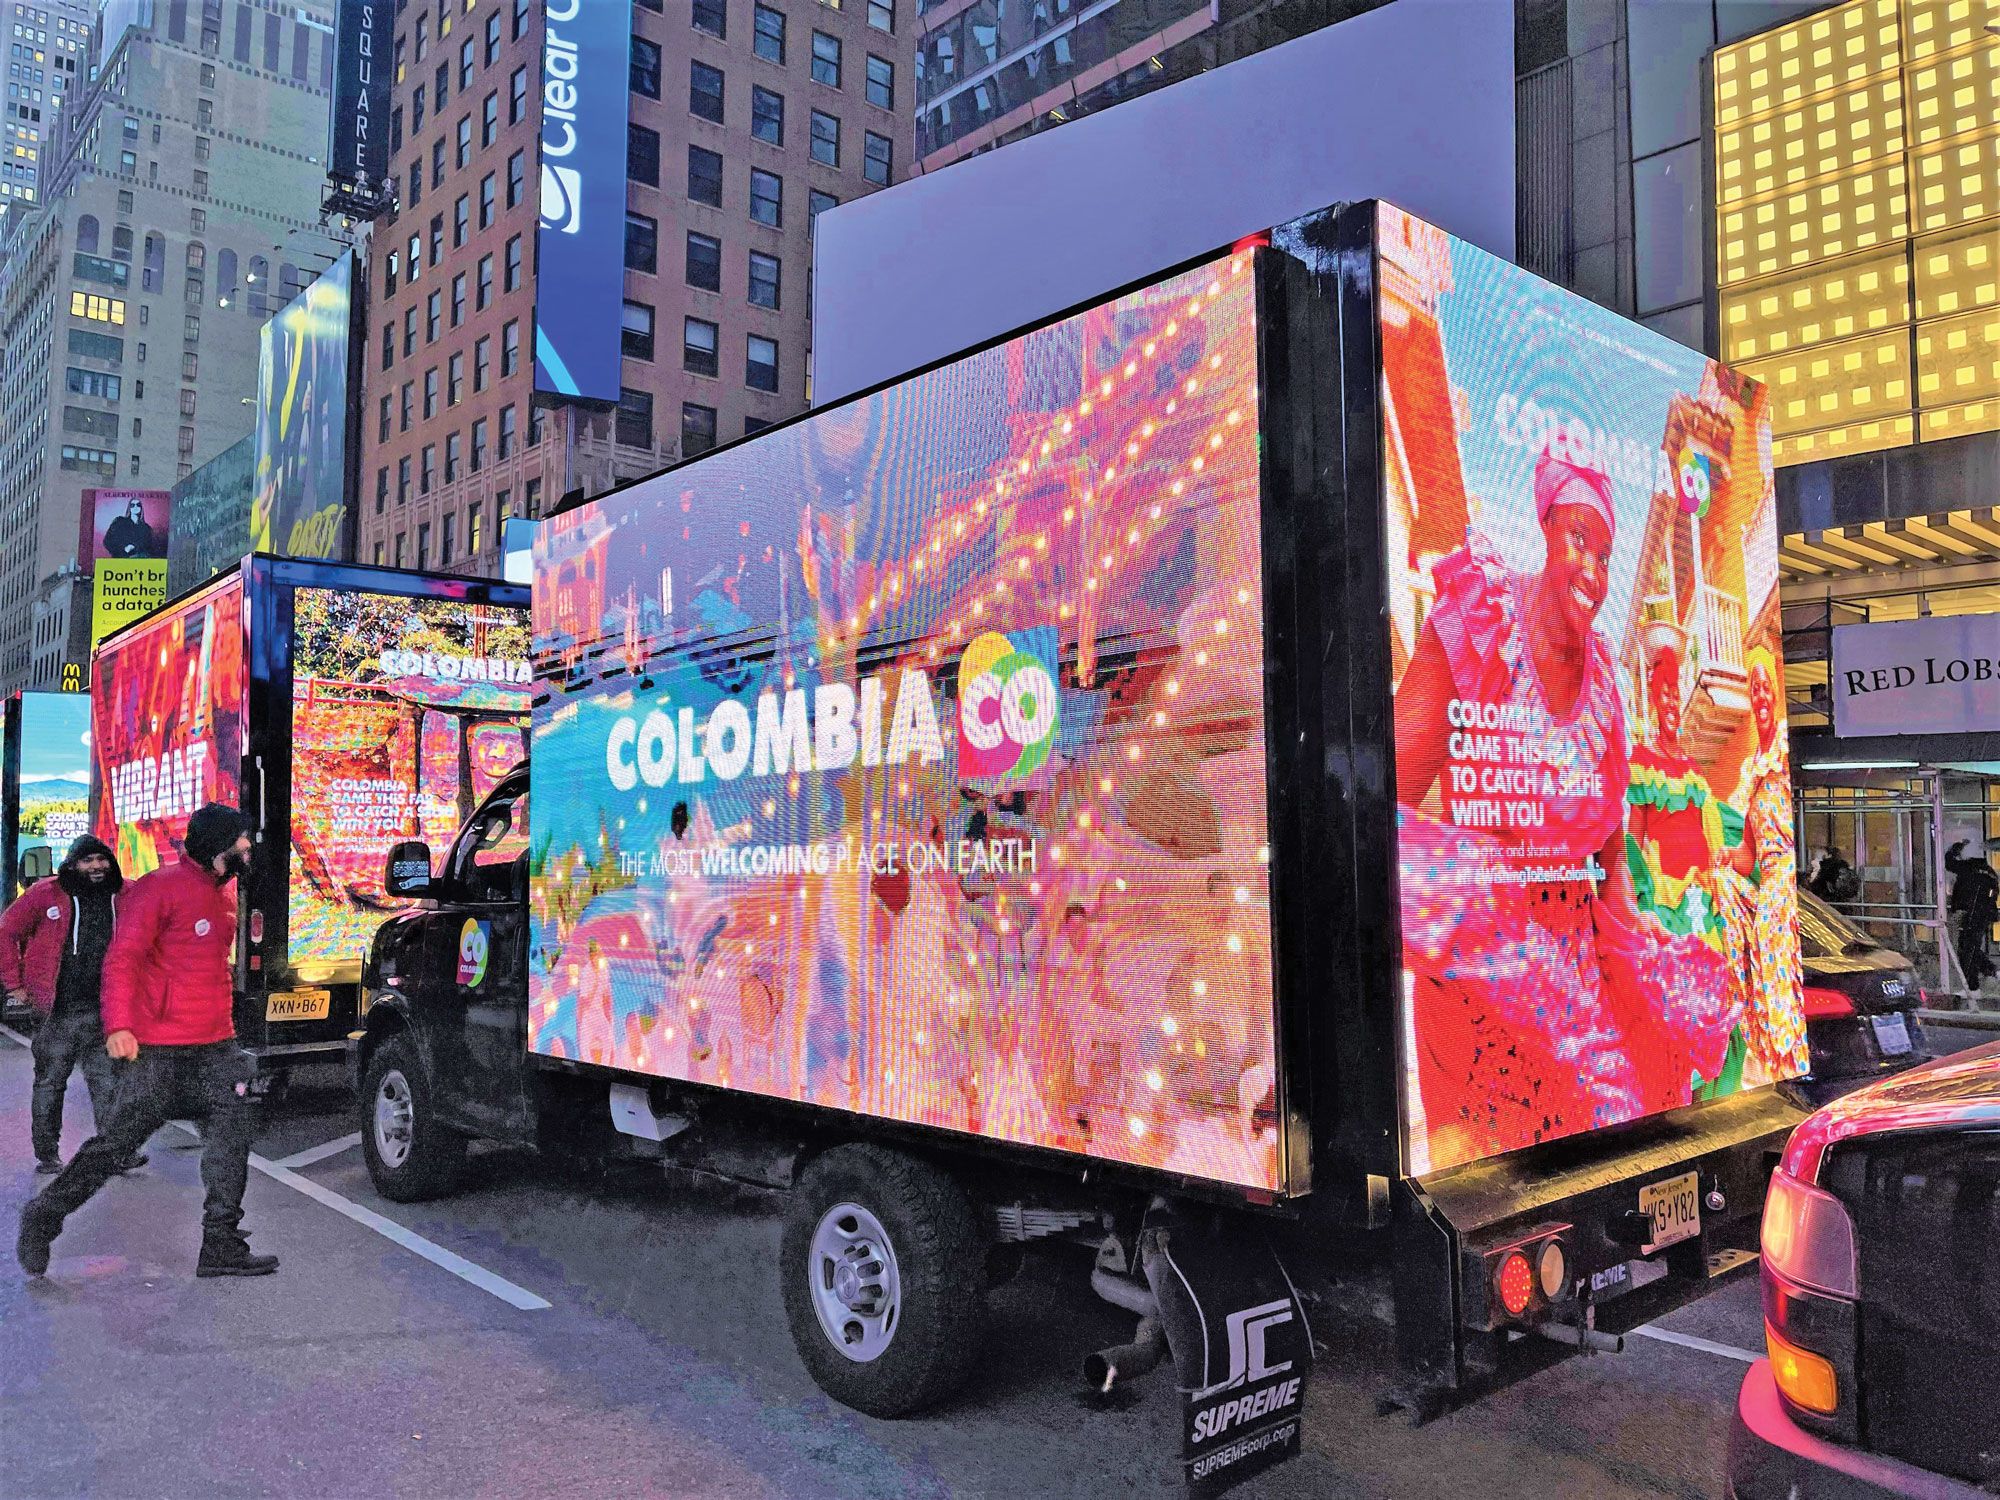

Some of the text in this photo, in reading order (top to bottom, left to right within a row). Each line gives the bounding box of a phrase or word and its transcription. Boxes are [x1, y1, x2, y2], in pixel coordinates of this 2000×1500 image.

[356, 5, 373, 166] SQUARE
[543, 28, 578, 156] Clear
[102, 584, 165, 596] hunches
[103, 569, 144, 582] Don't
[102, 602, 112, 611] a
[115, 598, 153, 611] data
[380, 650, 533, 684] COLOMBIA
[1844, 666, 1916, 696] RED
[962, 666, 1057, 751] CO
[606, 667, 945, 791] COLOMBIA
[1449, 732, 1502, 762] CAME
[1506, 736, 1543, 765] THIS
[110, 741, 208, 825] VIBRANT
[331, 779, 408, 792] COLOMBIA
[1450, 765, 1478, 793] TO
[1481, 767, 1538, 796] CATCH
[1541, 771, 1557, 797] A
[331, 805, 351, 818] TO
[354, 805, 400, 818] CATCH
[403, 806, 415, 818] A
[332, 791, 373, 804] CAME
[375, 792, 406, 805] THIS
[1450, 798, 1545, 828] WITH YOU
[374, 818, 404, 831] YOU
[619, 838, 1037, 877] THE MOST WELCOMING PLACE ON EARTH
[1505, 839, 1525, 857] and
[1192, 1377, 1302, 1444] SUPREME
